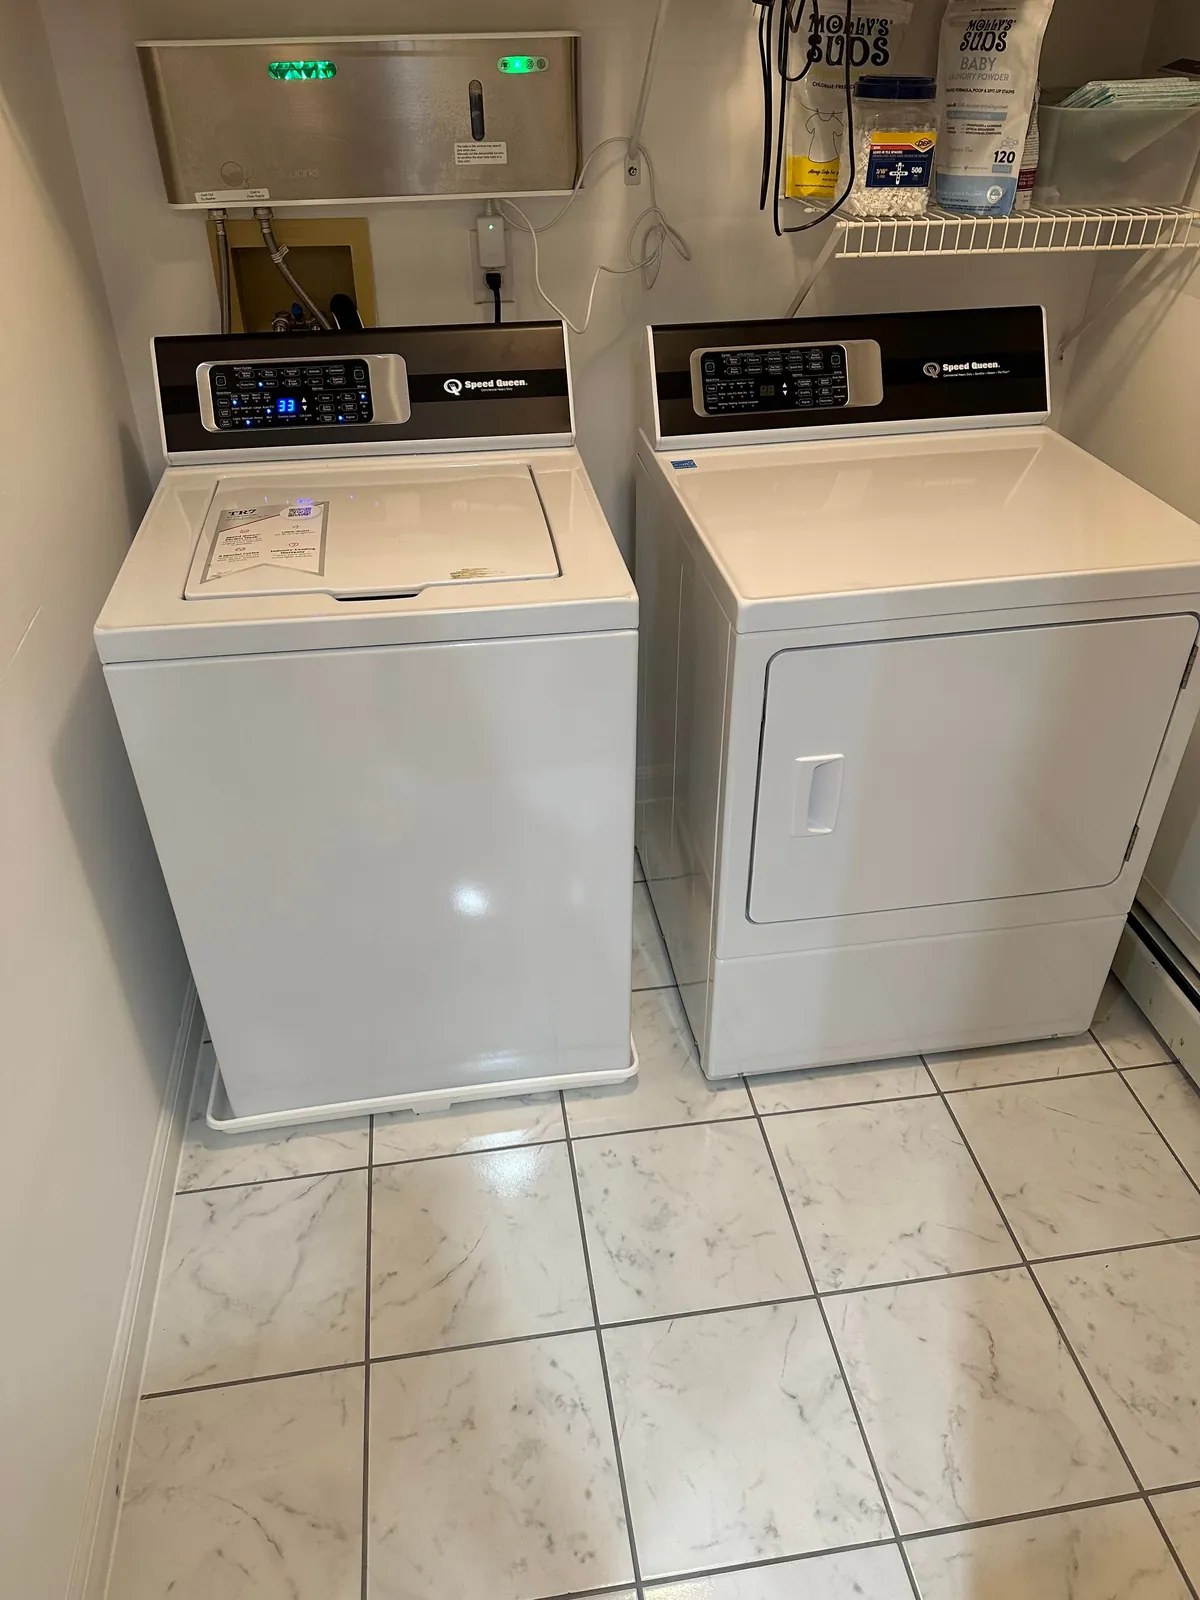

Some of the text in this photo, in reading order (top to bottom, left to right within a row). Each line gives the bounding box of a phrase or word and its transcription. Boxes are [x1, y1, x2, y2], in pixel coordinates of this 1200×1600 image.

[966, 19, 1013, 31] MOLLY'S
[960, 31, 1008, 52] SUDS
[806, 34, 890, 66] SUDS
[960, 56, 997, 71] BABY
[977, 73, 1009, 81] POWDER
[993, 150, 1016, 164] 120
[911, 166, 923, 174] 500
[942, 363, 970, 372] Speed
[464, 380, 494, 390] Speed
[278, 399, 295, 412] 33
